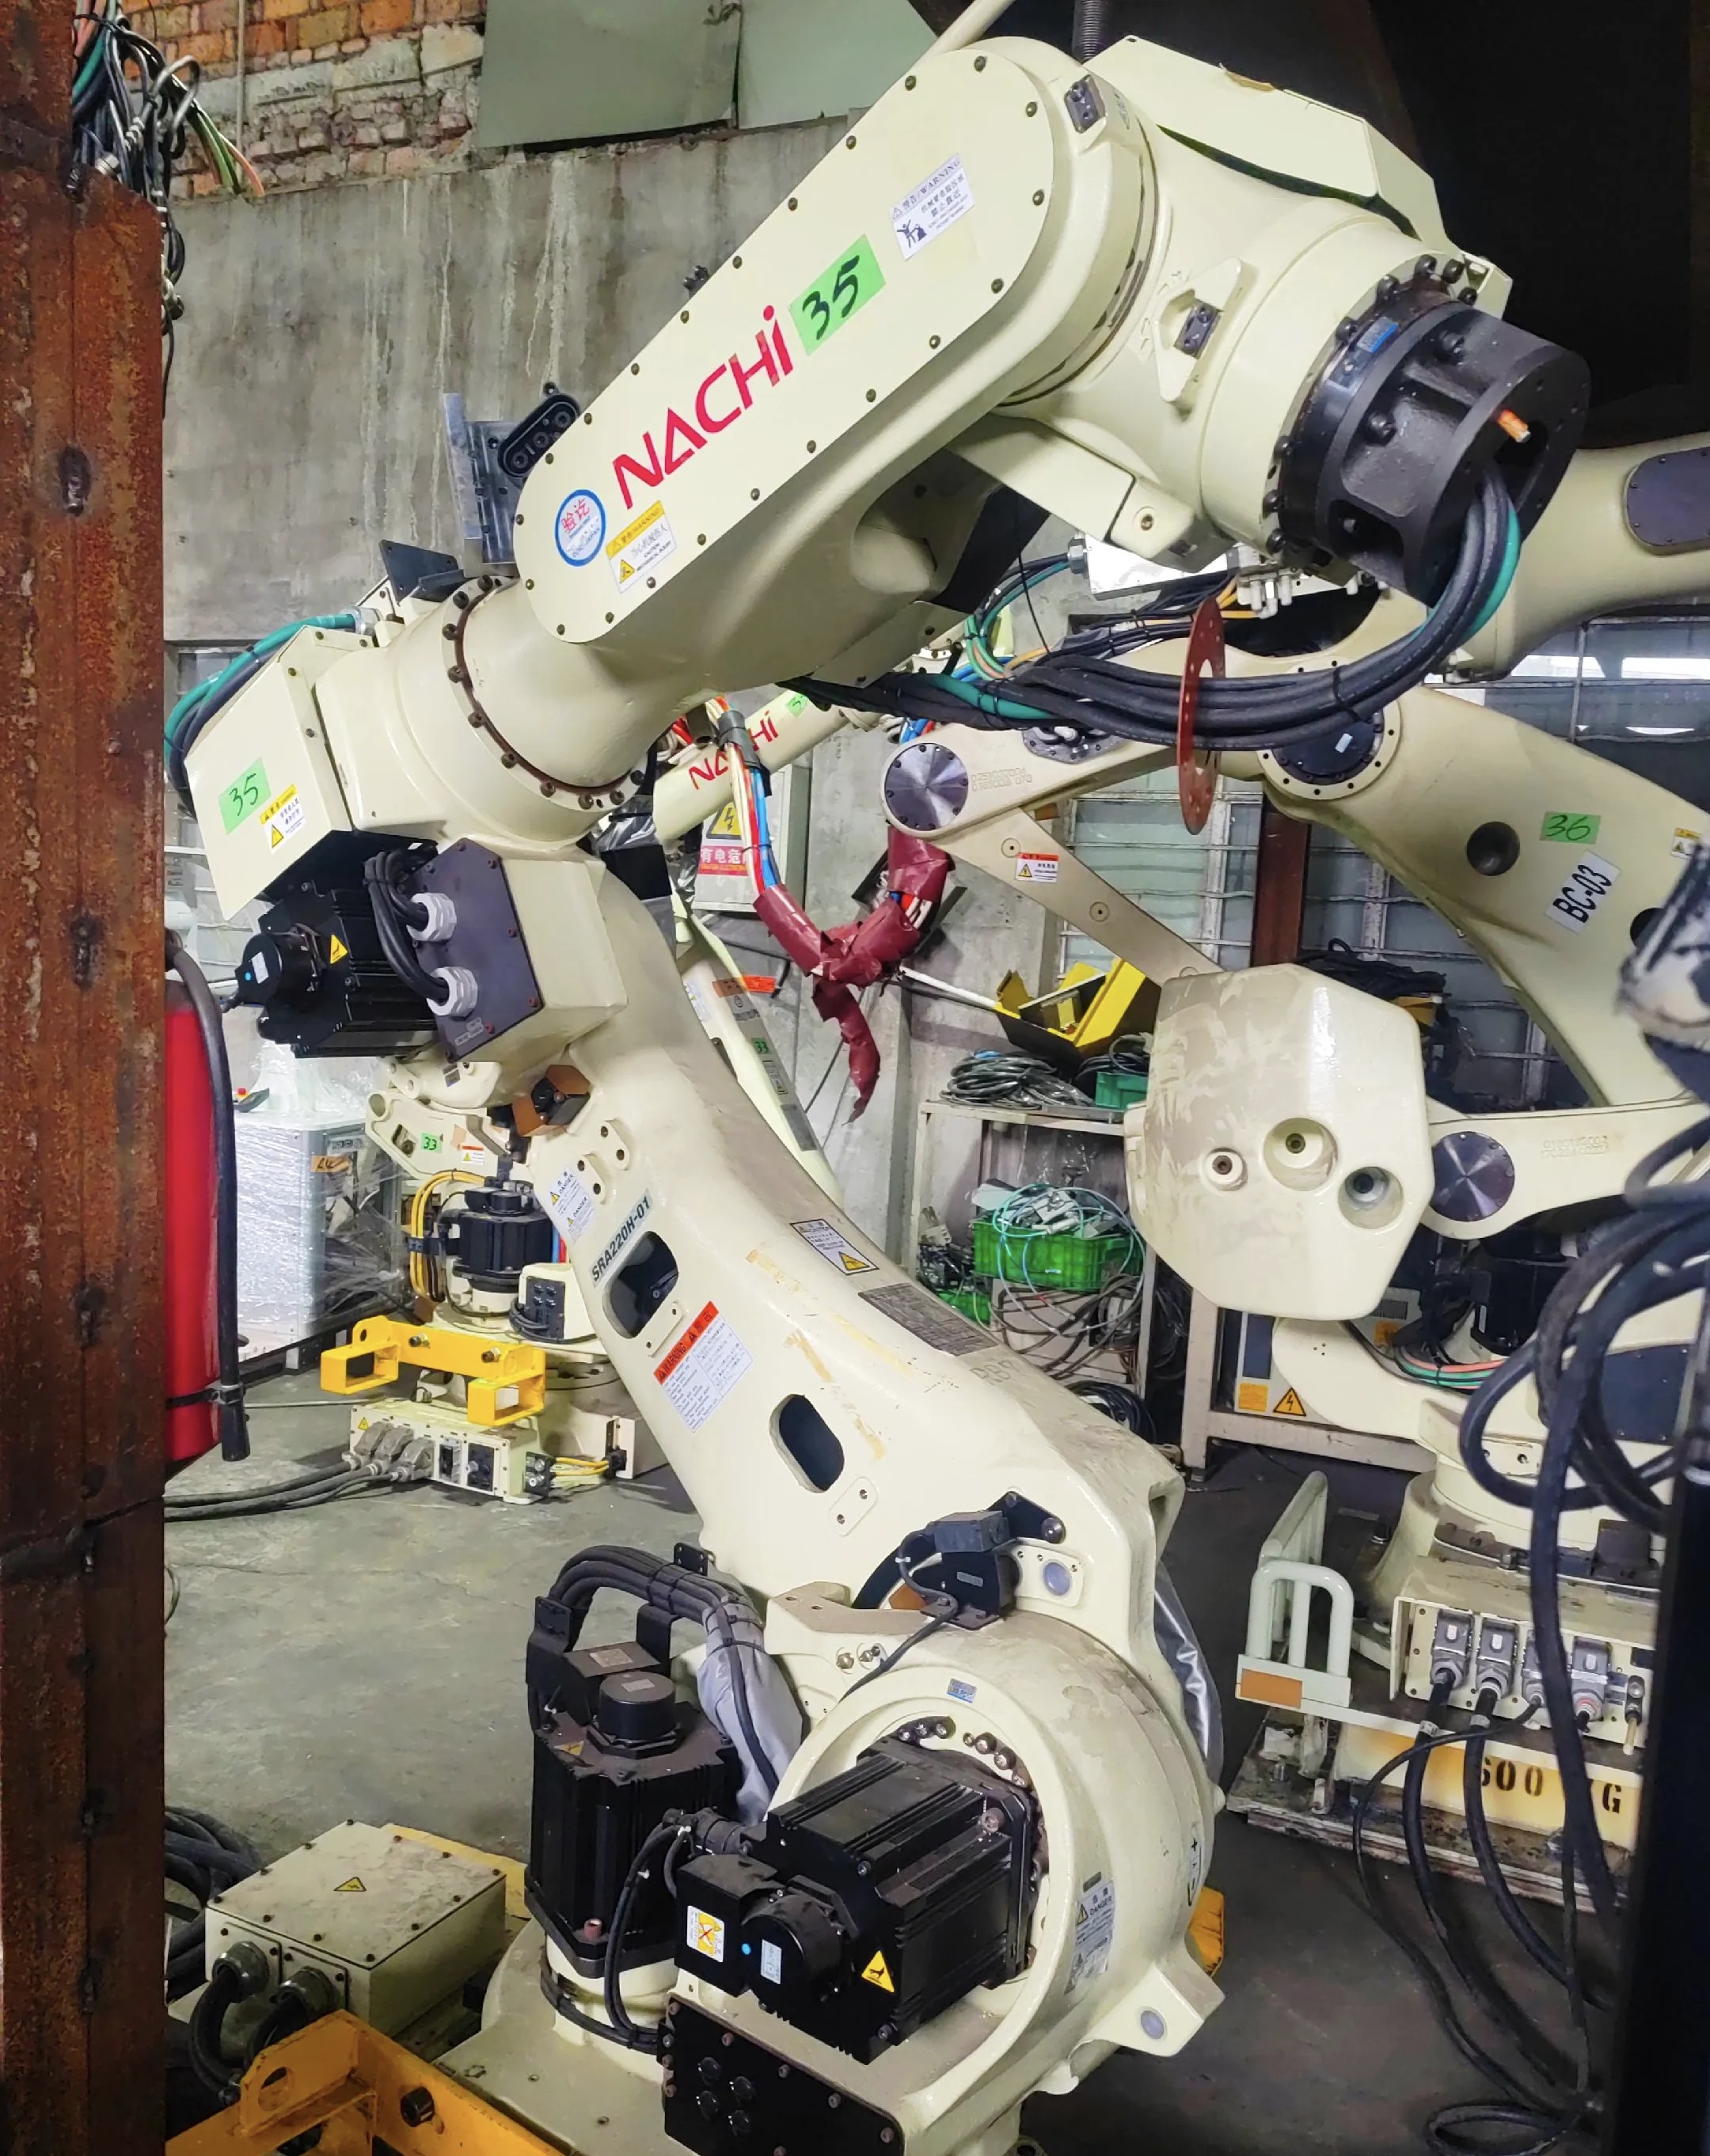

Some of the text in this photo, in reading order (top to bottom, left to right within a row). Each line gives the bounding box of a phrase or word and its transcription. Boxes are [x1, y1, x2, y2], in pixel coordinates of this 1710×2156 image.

[802, 255, 860, 341] 35
[229, 773, 259, 816] 35
[1546, 814, 1590, 841] 36
[701, 848, 746, 864] 有电危
[424, 1137, 436, 1150] 33
[592, 1196, 651, 1281] SRA220H-01
